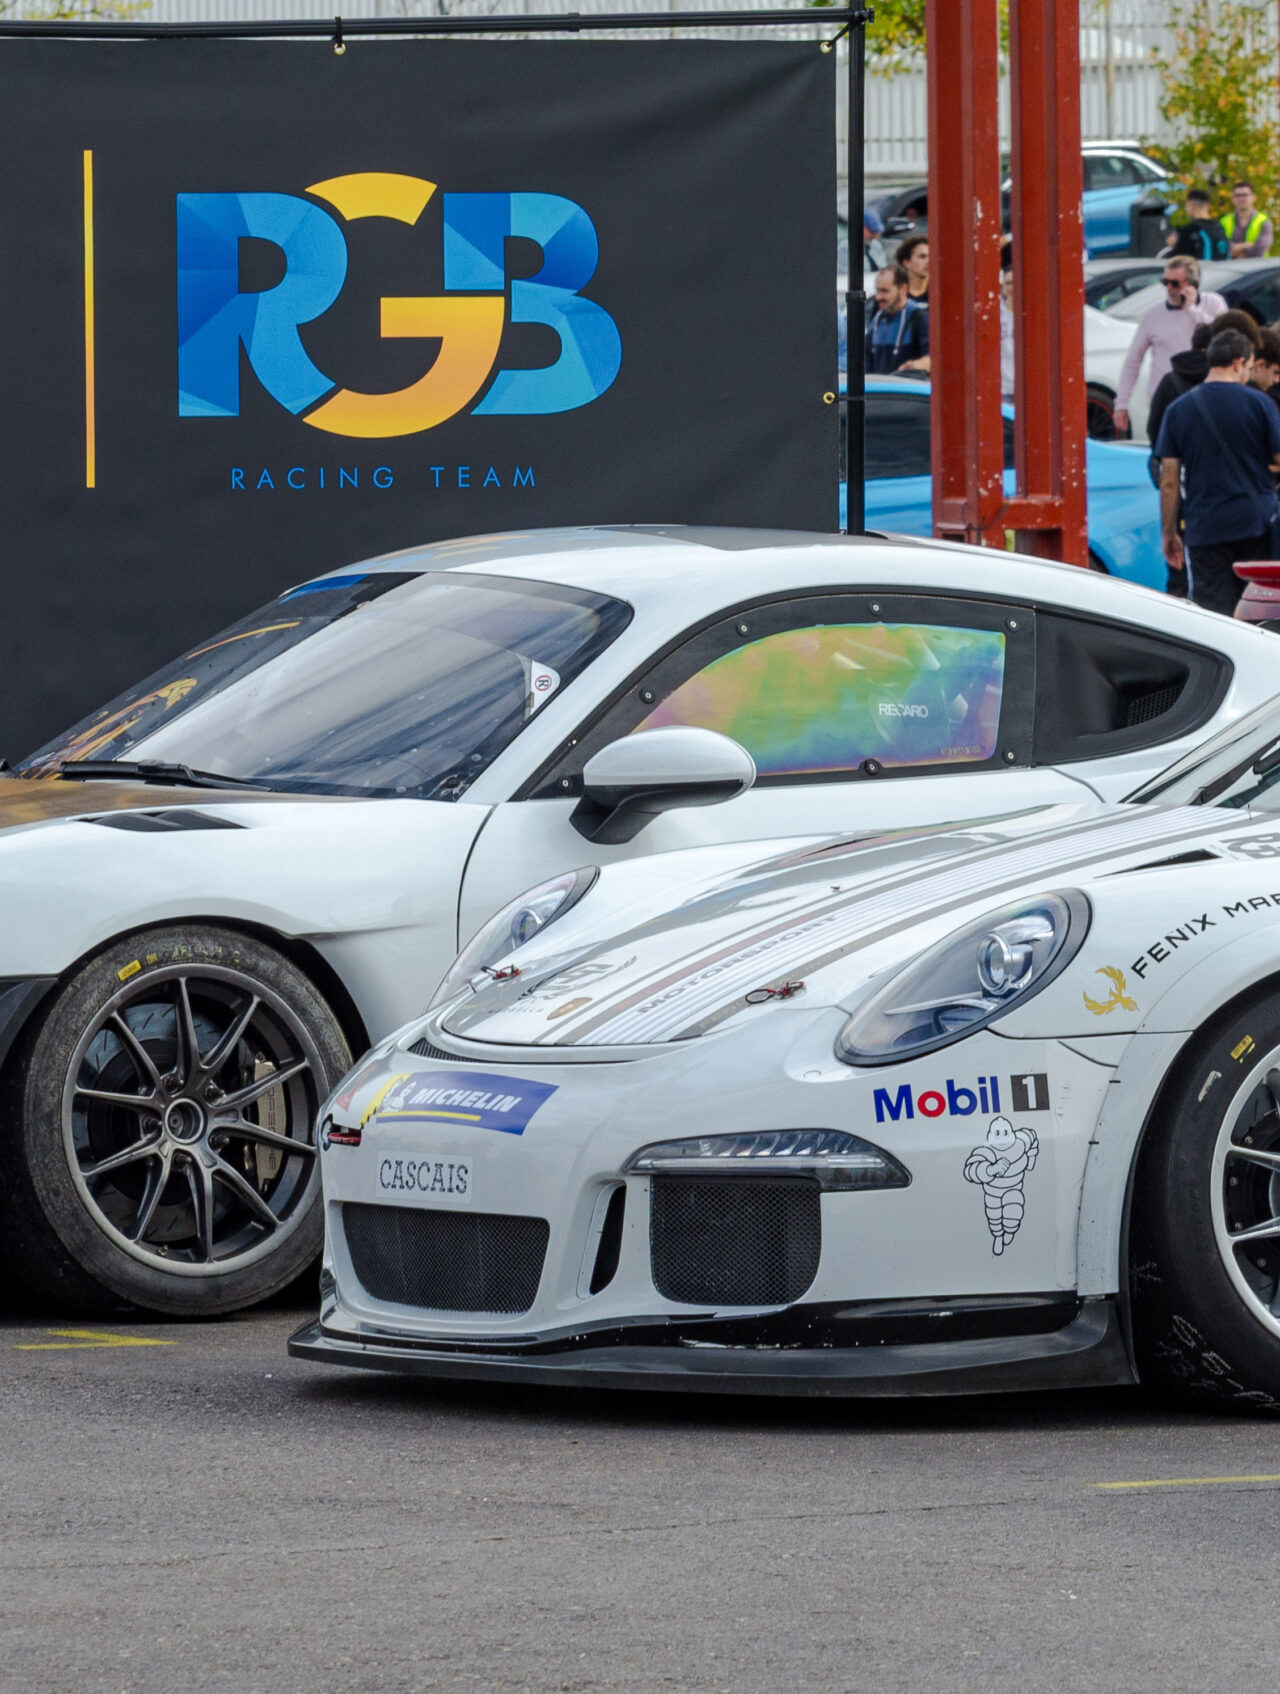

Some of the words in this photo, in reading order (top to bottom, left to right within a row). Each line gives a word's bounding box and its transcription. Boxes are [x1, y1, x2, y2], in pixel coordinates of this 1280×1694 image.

[176, 172, 622, 438] RGB
[230, 466, 394, 489] RACING
[429, 465, 536, 488] TEAM
[637, 914, 836, 1014] MOTORSPORT
[1130, 913, 1217, 979] FENIX
[409, 1087, 523, 1113] MICHELIN
[873, 1075, 1001, 1123] Mobil
[1021, 1075, 1038, 1110] 1
[379, 1159, 468, 1194] CASCAIS
